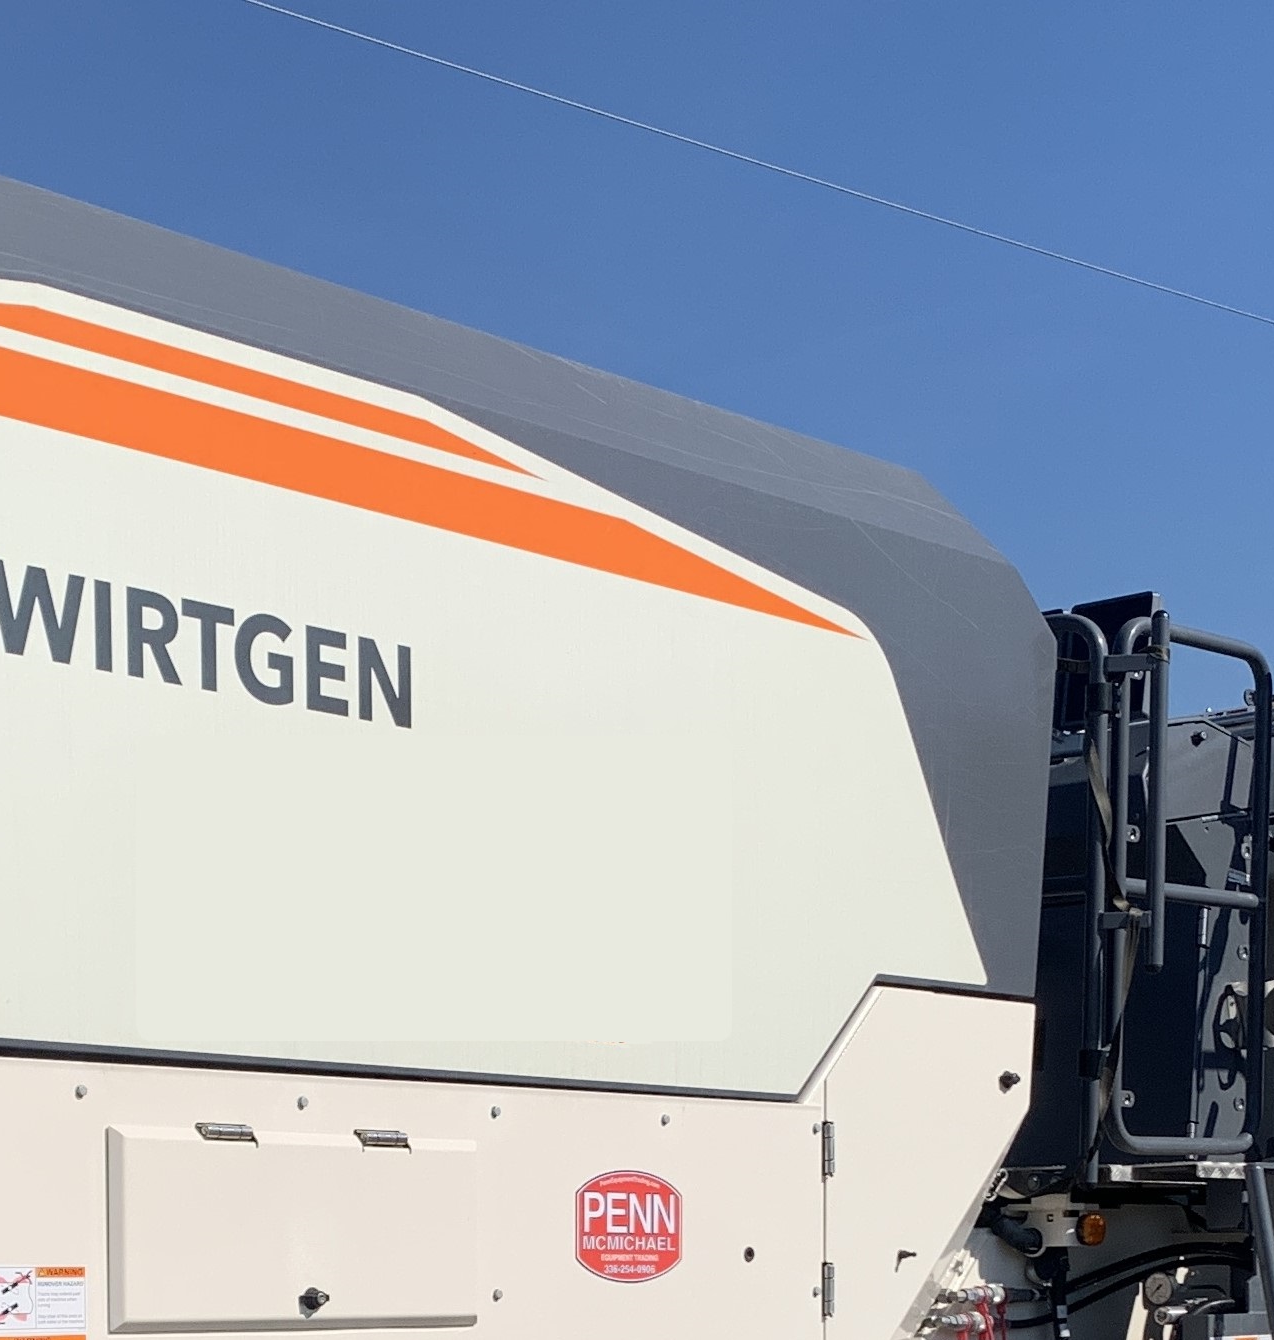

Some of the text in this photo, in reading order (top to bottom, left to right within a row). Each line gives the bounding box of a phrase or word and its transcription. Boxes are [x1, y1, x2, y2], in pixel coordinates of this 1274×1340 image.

[583, 1191, 676, 1234] PENN
[582, 1235, 676, 1251] MCMICHAEL
[46, 1267, 84, 1276] WARNING
